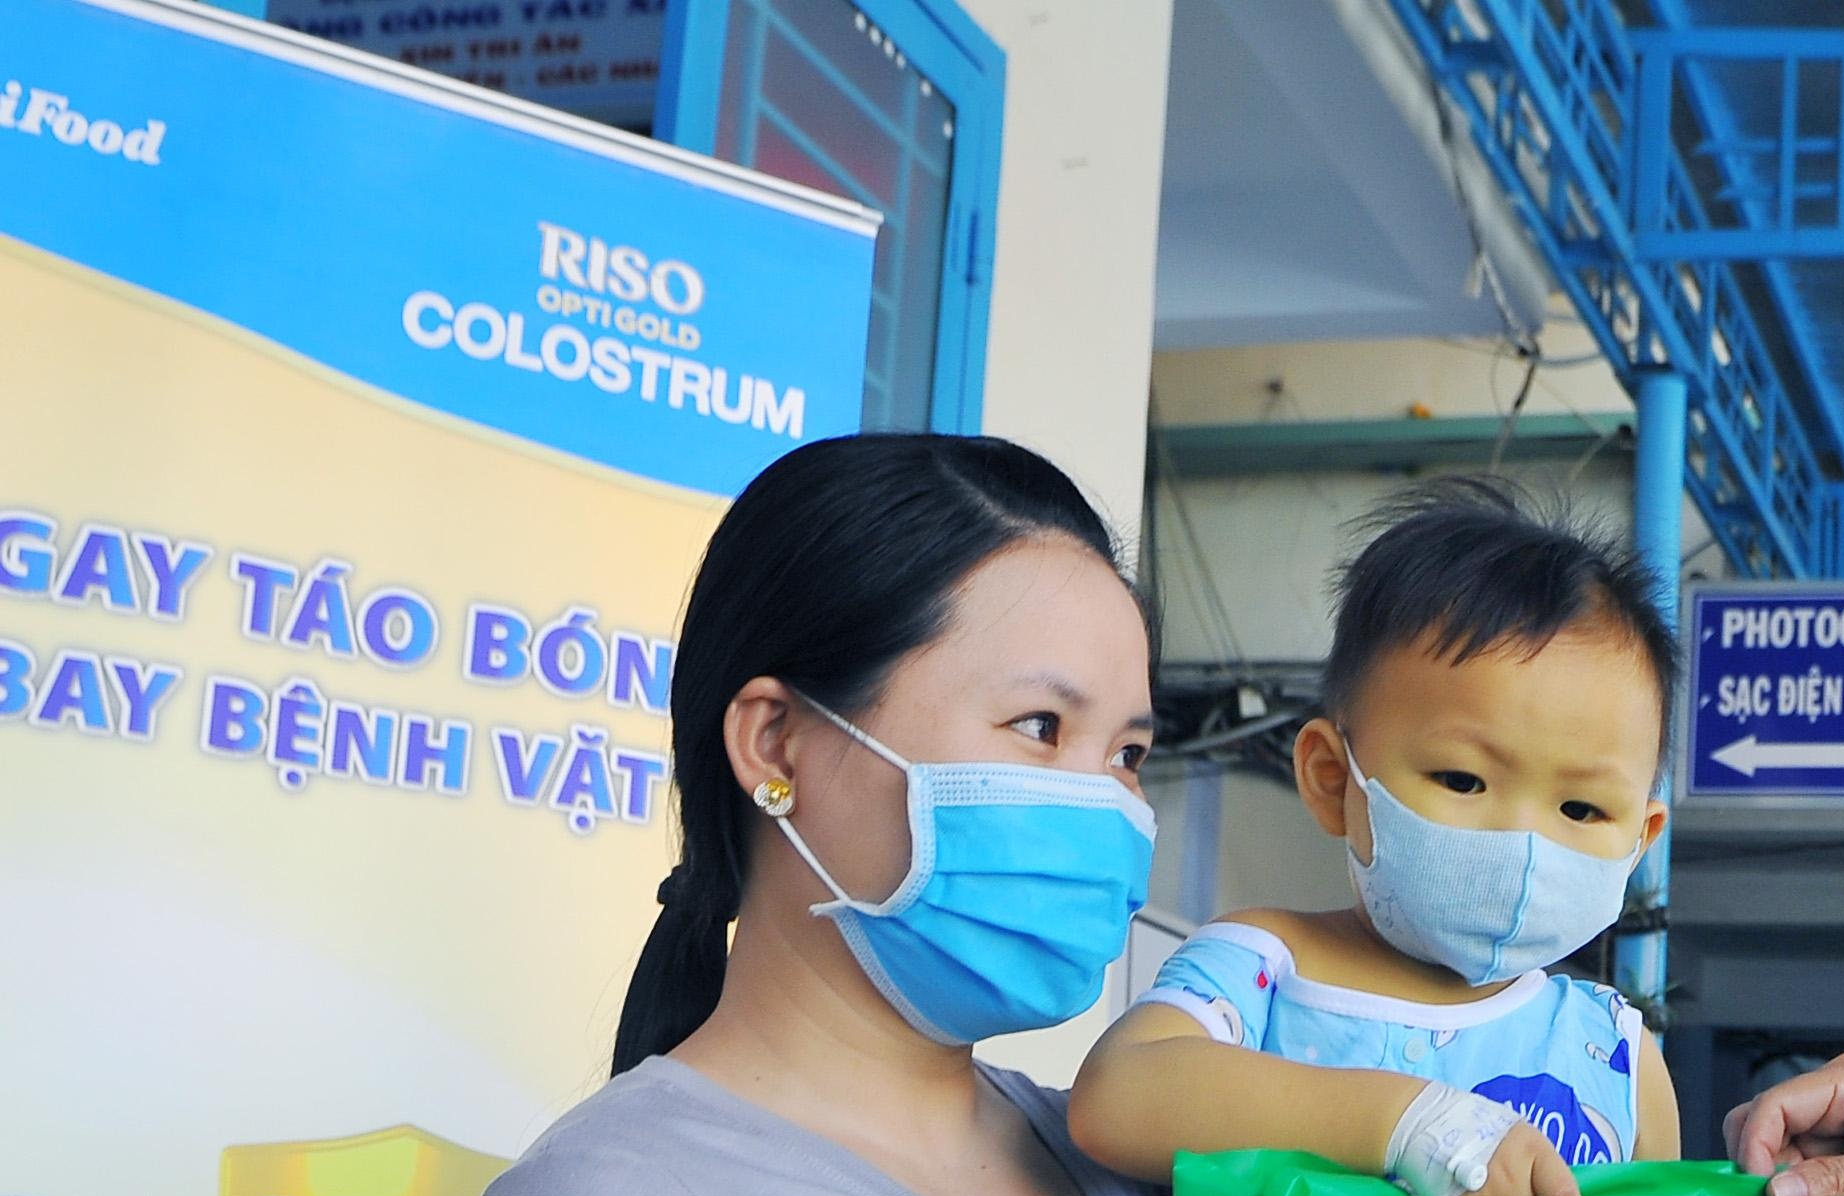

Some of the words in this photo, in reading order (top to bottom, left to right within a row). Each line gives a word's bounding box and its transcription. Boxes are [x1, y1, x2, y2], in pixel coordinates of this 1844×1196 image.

[537, 221, 705, 316] RISO
[402, 290, 806, 439] COLOSTRUM
[231, 554, 438, 668] TÁO
[465, 605, 674, 712] BÓN
[1718, 675, 1771, 724] SẠC
[1777, 663, 1843, 724] ĐIỆN
[202, 678, 469, 790] BỆNH
[493, 724, 667, 832] VẶT
